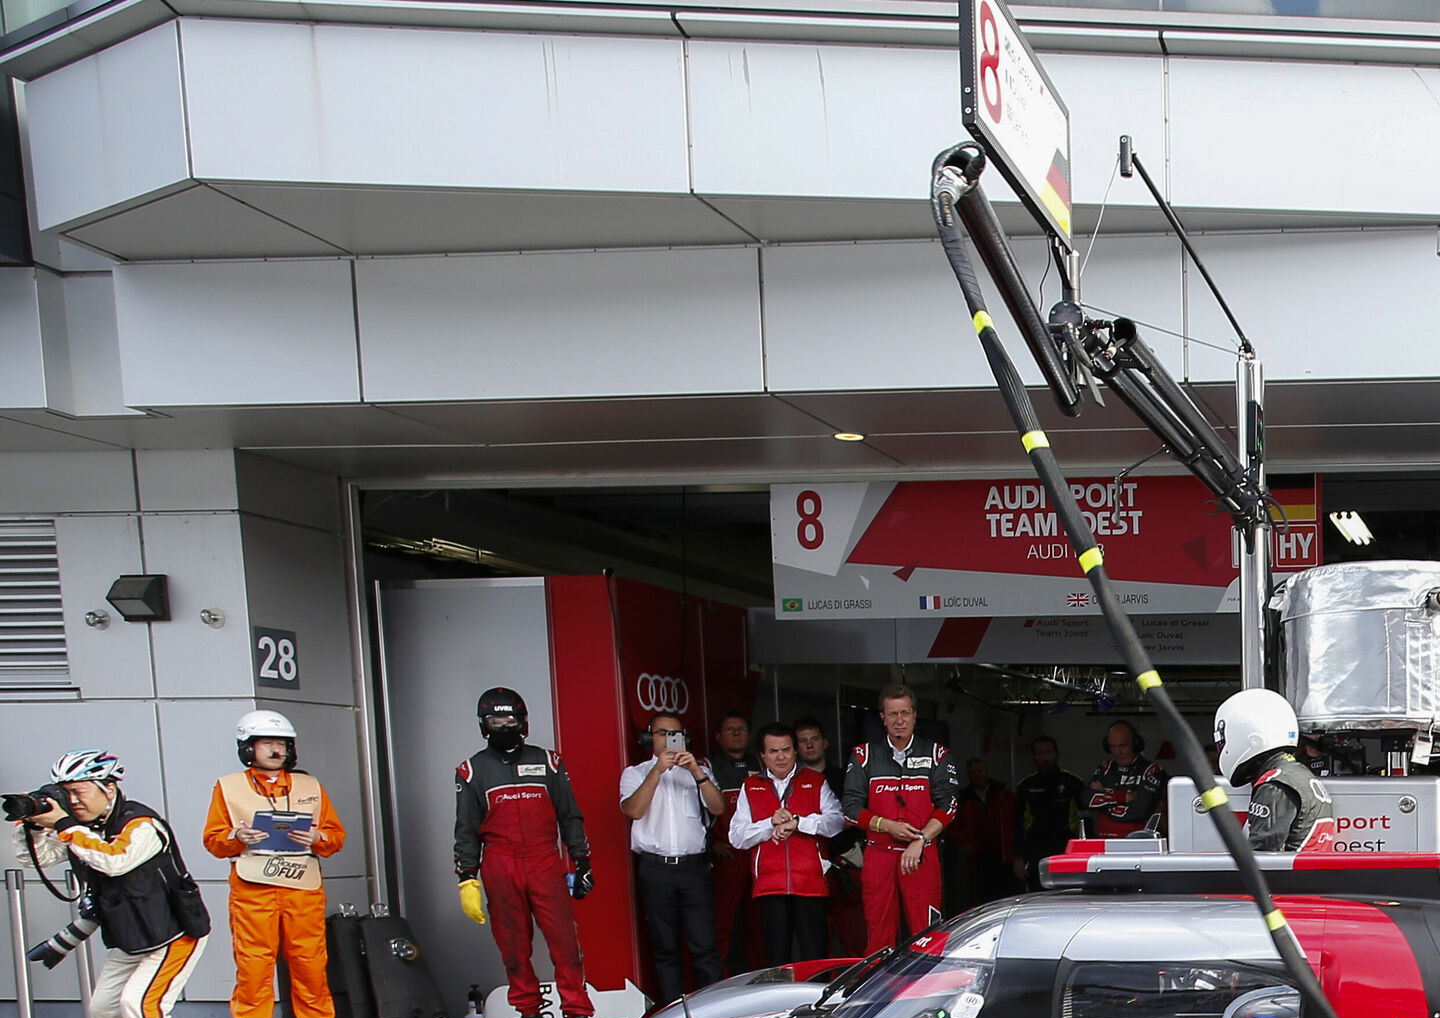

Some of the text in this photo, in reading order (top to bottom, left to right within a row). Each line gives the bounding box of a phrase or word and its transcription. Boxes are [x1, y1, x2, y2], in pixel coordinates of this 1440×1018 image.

[980, 0, 1002, 124] 8
[984, 483, 1138, 510] AUDI PORT
[796, 489, 825, 551] 8
[986, 510, 1143, 538] TEAM OEST
[1027, 543, 1068, 560] AUDI
[1279, 532, 1315, 560] HY
[807, 599, 872, 610] LUCAS DI GRASSI
[963, 597, 988, 607] DUVAL
[1121, 594, 1149, 604] JARVIS
[1141, 619, 1168, 628] Lucas
[1182, 618, 1210, 627] Grassi
[1157, 631, 1183, 640] Duval
[1158, 643, 1184, 652] Jarvis
[257, 634, 298, 683] 28
[905, 784, 925, 793] Sport
[502, 792, 520, 800] Audi
[1336, 814, 1391, 833] port
[1334, 839, 1386, 852] oest
[277, 867, 306, 880] FUJI
